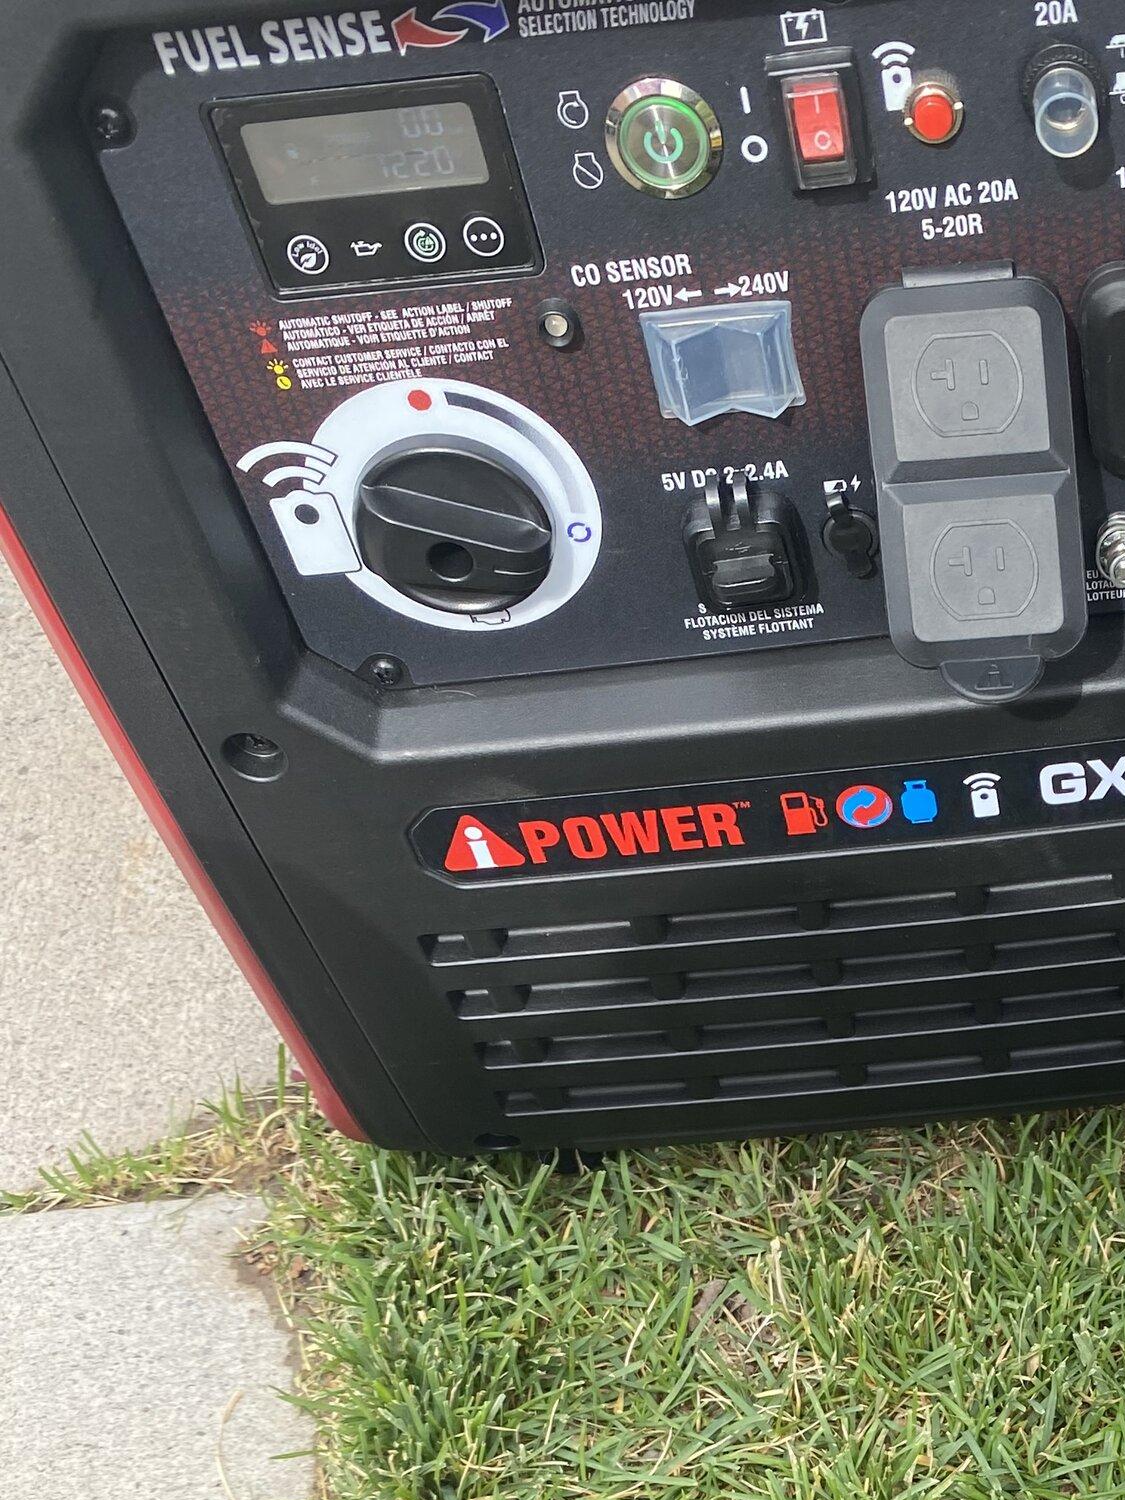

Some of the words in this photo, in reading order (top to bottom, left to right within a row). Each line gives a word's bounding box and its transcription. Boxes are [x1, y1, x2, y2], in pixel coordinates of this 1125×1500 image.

[518, 9, 598, 38] SELECTION
[601, 0, 696, 28] TECHNOLOGY
[1034, 1, 1079, 27] 20A
[152, 24, 261, 75] FUEL
[261, 9, 392, 65] SENSE
[885, 187, 938, 214] 120V
[944, 183, 973, 207] AC
[977, 178, 1020, 205] 20A
[920, 213, 983, 241] 5-20R
[570, 262, 601, 288] CO
[605, 253, 693, 284] SENSOR
[622, 284, 674, 310] 120V
[737, 270, 790, 297] 240V
[279, 316, 330, 330] AUTOMATIC
[331, 312, 373, 324] SHUTOFF
[380, 309, 398, 320] SEE
[402, 305, 435, 319] ACTION
[436, 302, 465, 315] LABEL
[471, 297, 512, 311] SHUTOFF
[282, 325, 341, 341] AUTOMÁTICO
[347, 323, 366, 335] VER
[367, 319, 411, 334] ETIQUETA
[411, 317, 425, 328] DE
[425, 313, 460, 328] ACCIÓN
[287, 336, 351, 352] AUTOMATIQUE
[356, 334, 381, 346] VOIR
[429, 324, 471, 338] D'ACTION
[292, 355, 333, 369] CONTACT
[334, 350, 384, 364] CUSTOMER
[384, 346, 422, 359] SERVICE
[428, 341, 476, 355] CONTACTO
[476, 339, 496, 350] CON
[496, 338, 509, 348] EL
[296, 365, 337, 379] SERVICIO
[338, 363, 352, 375] DE
[352, 359, 396, 374] ATENCIÓN
[397, 359, 410, 370] AL
[410, 355, 448, 369] CLIENTE
[453, 350, 494, 363] CONTACT
[300, 378, 325, 390] AVEC
[326, 376, 338, 387] LE
[338, 373, 376, 386] SERVICE
[661, 471, 686, 491] 5V
[723, 460, 789, 485] 22.4A
[684, 612, 747, 630] FLOTACION
[749, 608, 772, 622] DEL
[774, 603, 825, 619] SISTEMA
[702, 625, 757, 641] SYSTÈME
[758, 617, 814, 635] FLOTTANT
